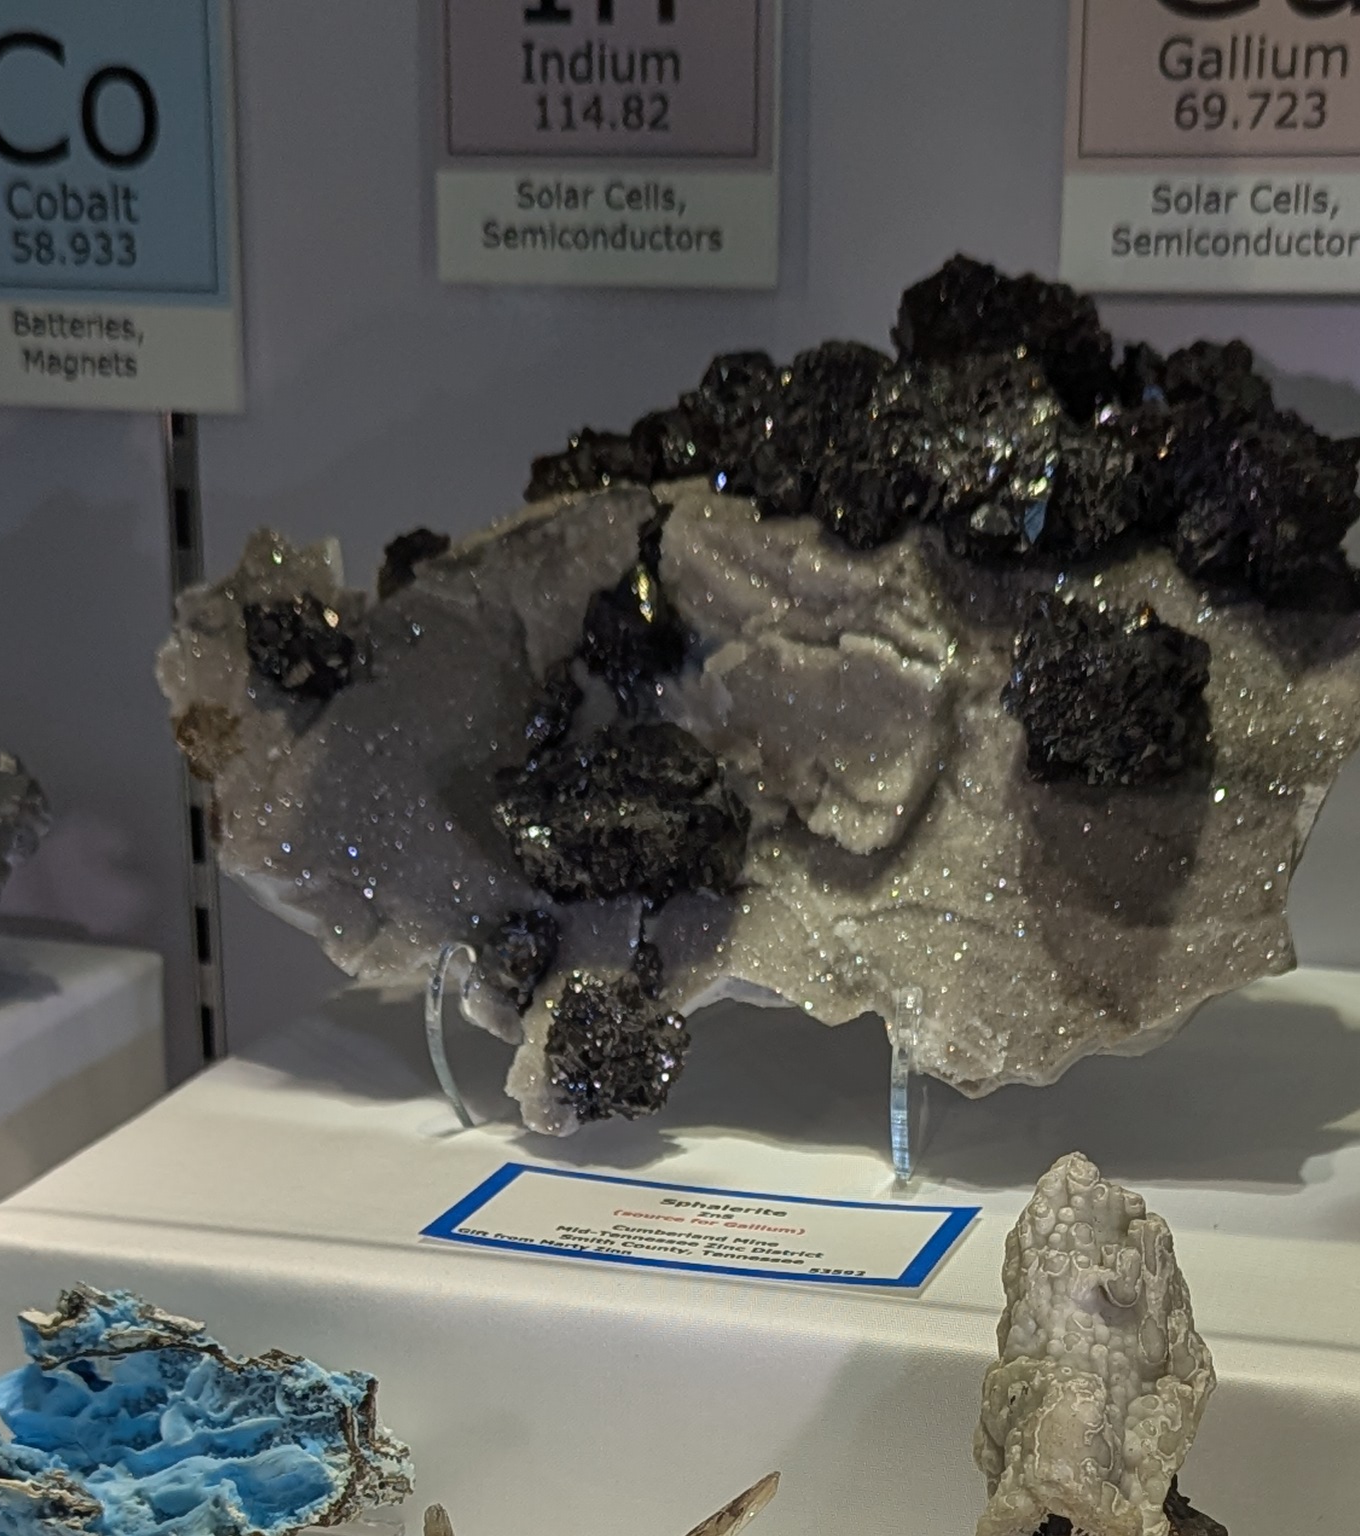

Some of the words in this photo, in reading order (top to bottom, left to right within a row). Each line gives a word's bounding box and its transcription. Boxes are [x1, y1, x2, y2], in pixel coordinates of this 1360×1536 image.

[521, 38, 681, 85] Indium
[1158, 33, 1349, 83] Gallium
[536, 91, 670, 132] 114.82
[1174, 87, 1327, 132] 69.723
[4, 178, 139, 225] Cobalt
[516, 179, 595, 210] Solar
[604, 180, 686, 217] Cells,
[1151, 182, 1238, 215] Solar
[1250, 182, 1339, 220] Cells,
[11, 227, 137, 267] 58.933
[482, 218, 723, 252] Semiconductors
[10, 307, 144, 345] Batteries,
[21, 347, 138, 382] Magnets
